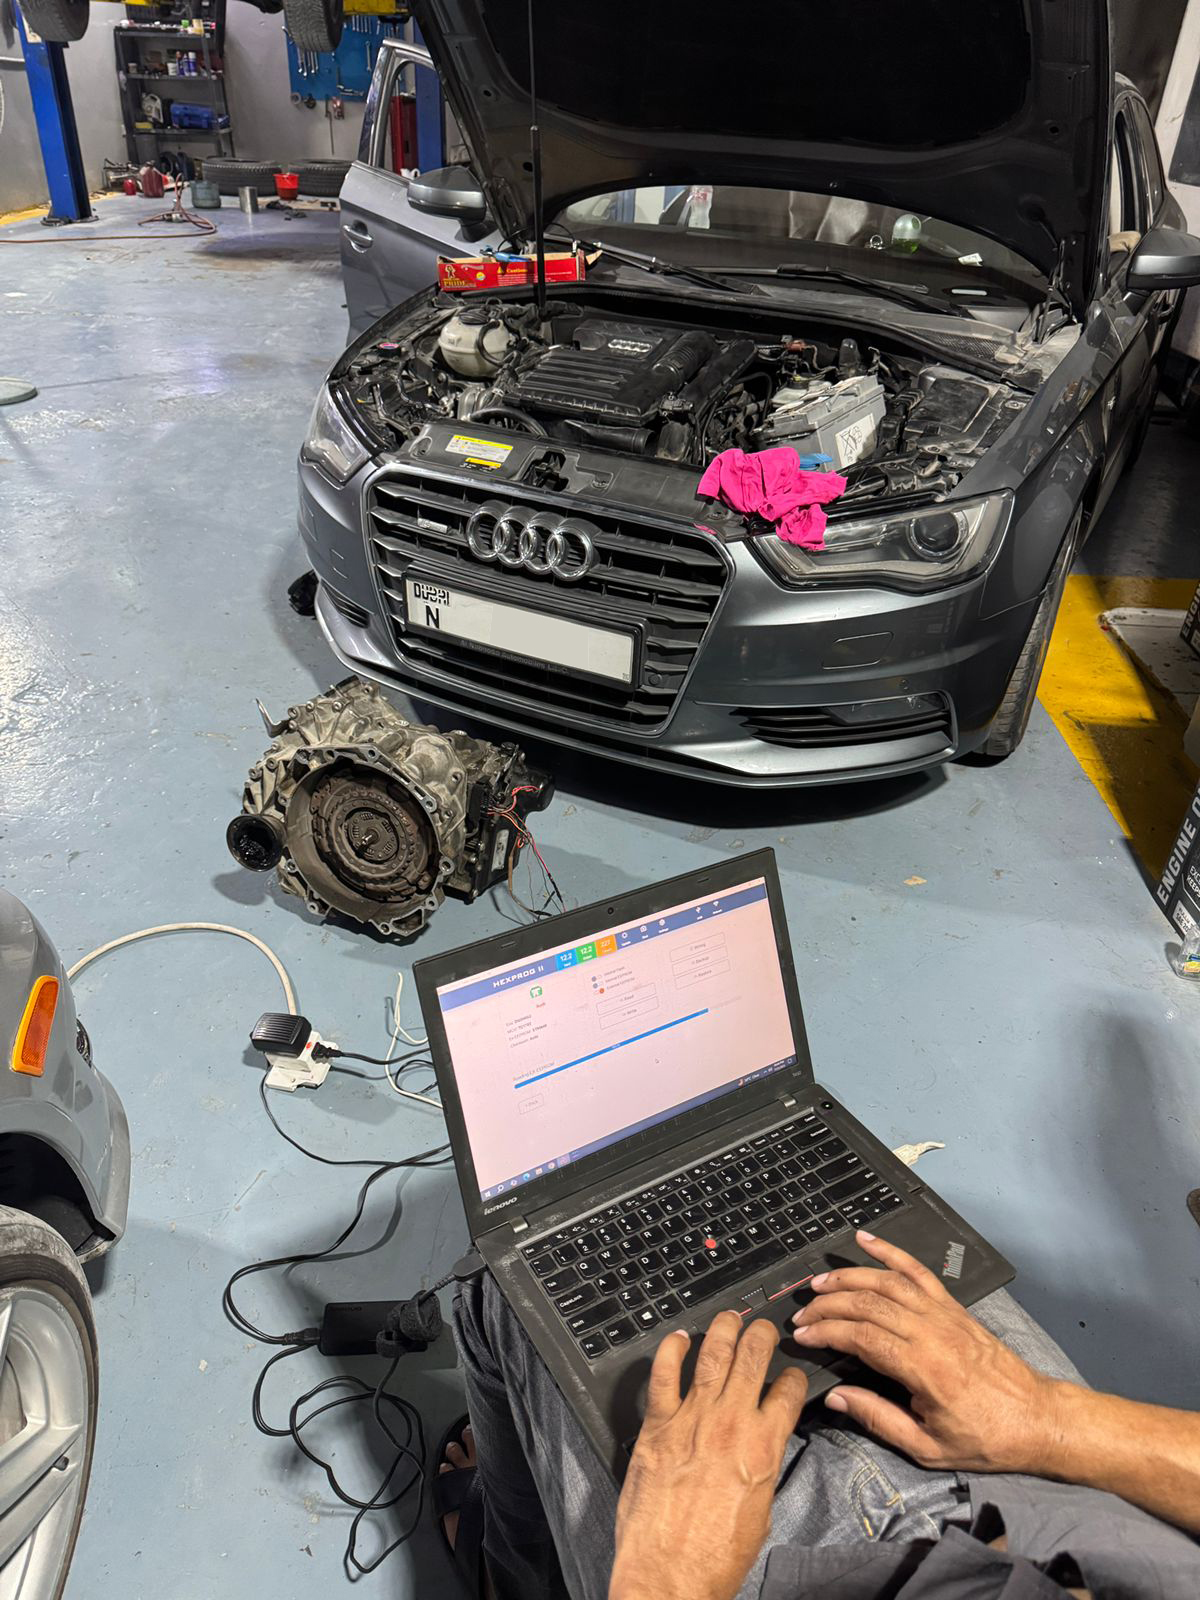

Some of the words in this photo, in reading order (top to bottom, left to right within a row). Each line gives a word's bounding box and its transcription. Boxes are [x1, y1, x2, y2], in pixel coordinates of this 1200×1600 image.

[425, 604, 440, 630] N
[1156, 817, 1197, 906] ENGINE
[559, 952, 573, 961] 12.2
[580, 946, 593, 955] 12.2
[493, 968, 536, 988] HEXPROG
[537, 965, 545, 973] II
[483, 1196, 518, 1216] lenovo
[942, 1240, 966, 1280] ThinkPad
